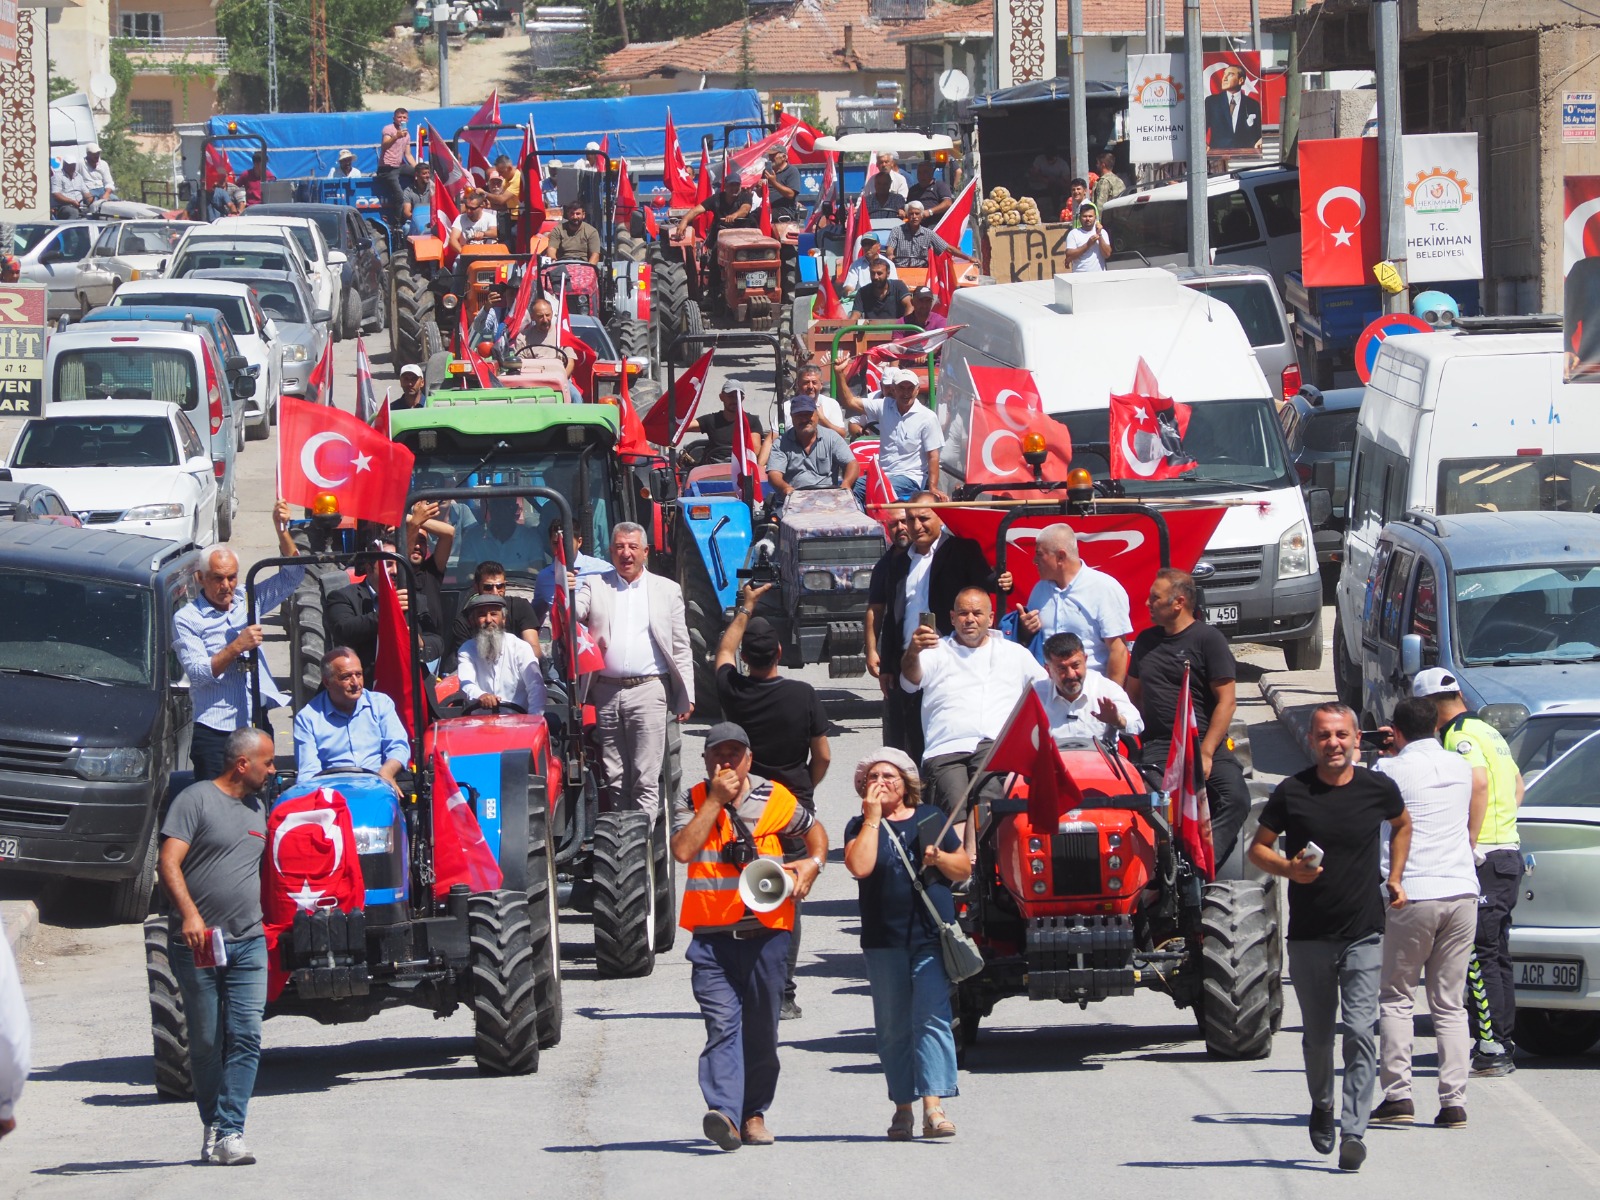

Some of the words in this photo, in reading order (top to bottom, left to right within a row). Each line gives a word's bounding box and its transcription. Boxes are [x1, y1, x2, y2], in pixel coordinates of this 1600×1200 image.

[1572, 116, 1579, 124] Ay
[1136, 124, 1184, 133] HEKİMHAN
[1430, 222, 1448, 231] T.C.
[1407, 235, 1472, 247] HEKİMHAN
[1416, 249, 1464, 258] BELEDİYESİ
[18, 364, 27, 373] 12
[1217, 608, 1236, 620] 450
[1521, 964, 1545, 984] ACR
[1552, 966, 1577, 986] 906
